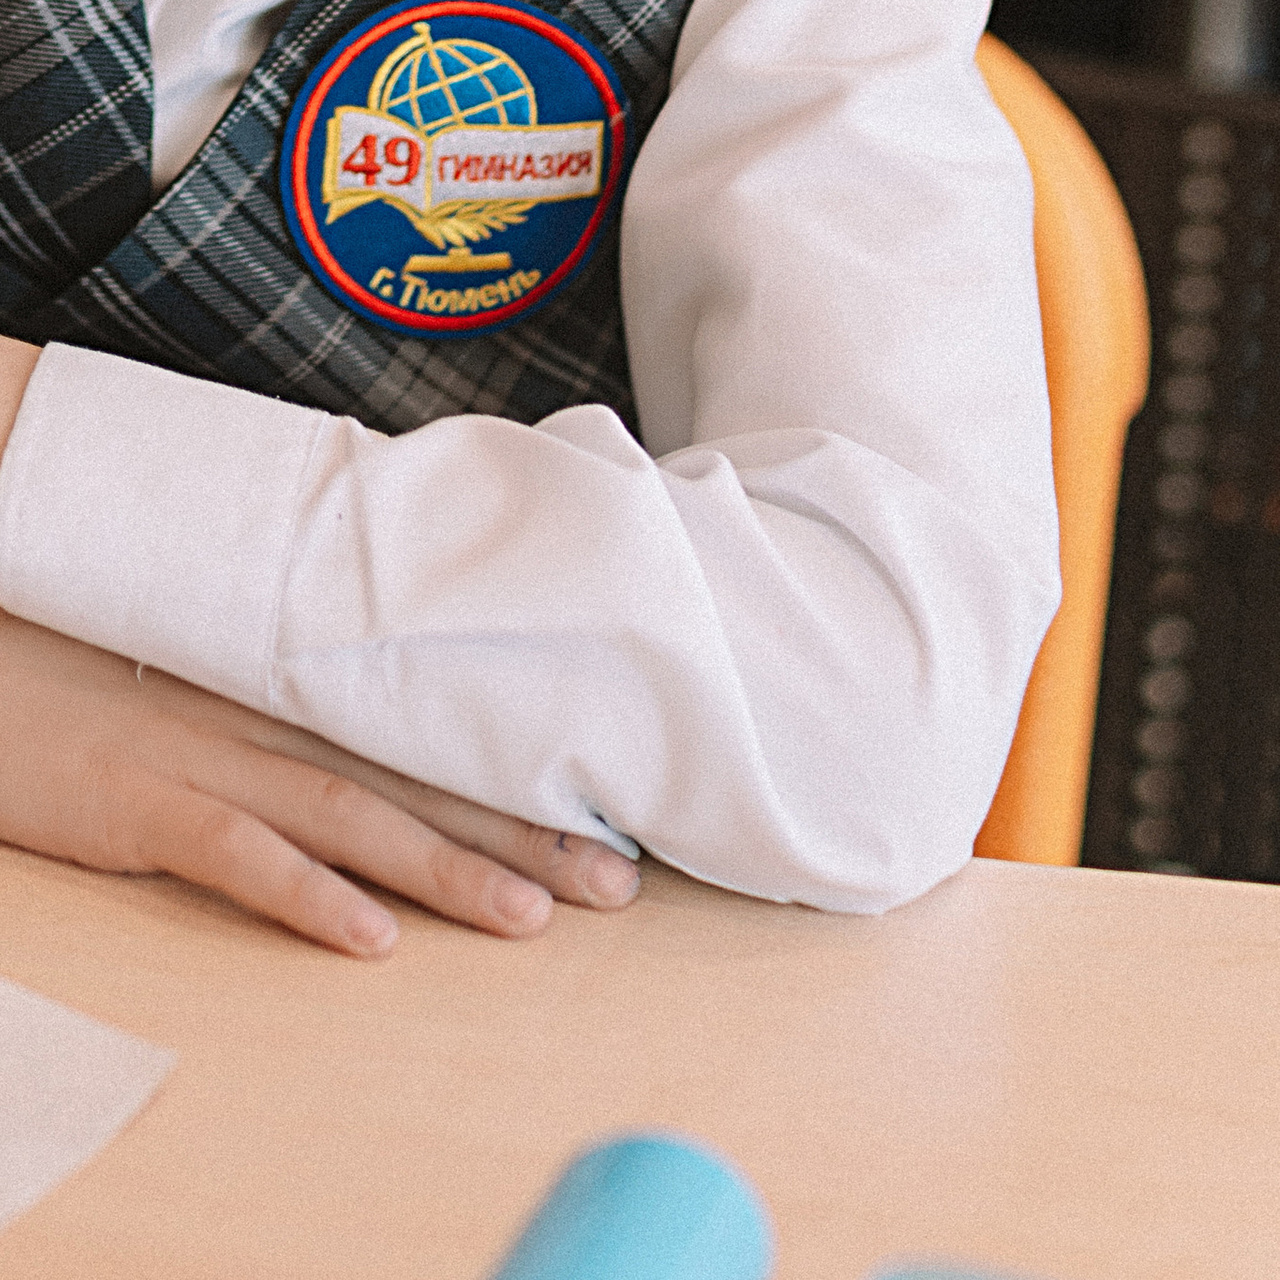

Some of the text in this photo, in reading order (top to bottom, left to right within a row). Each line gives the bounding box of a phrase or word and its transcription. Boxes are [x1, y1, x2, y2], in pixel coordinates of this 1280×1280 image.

[342, 134, 593, 186] 49 ГИМНАЗИЯ
[401, 270, 542, 313] Тюмень
